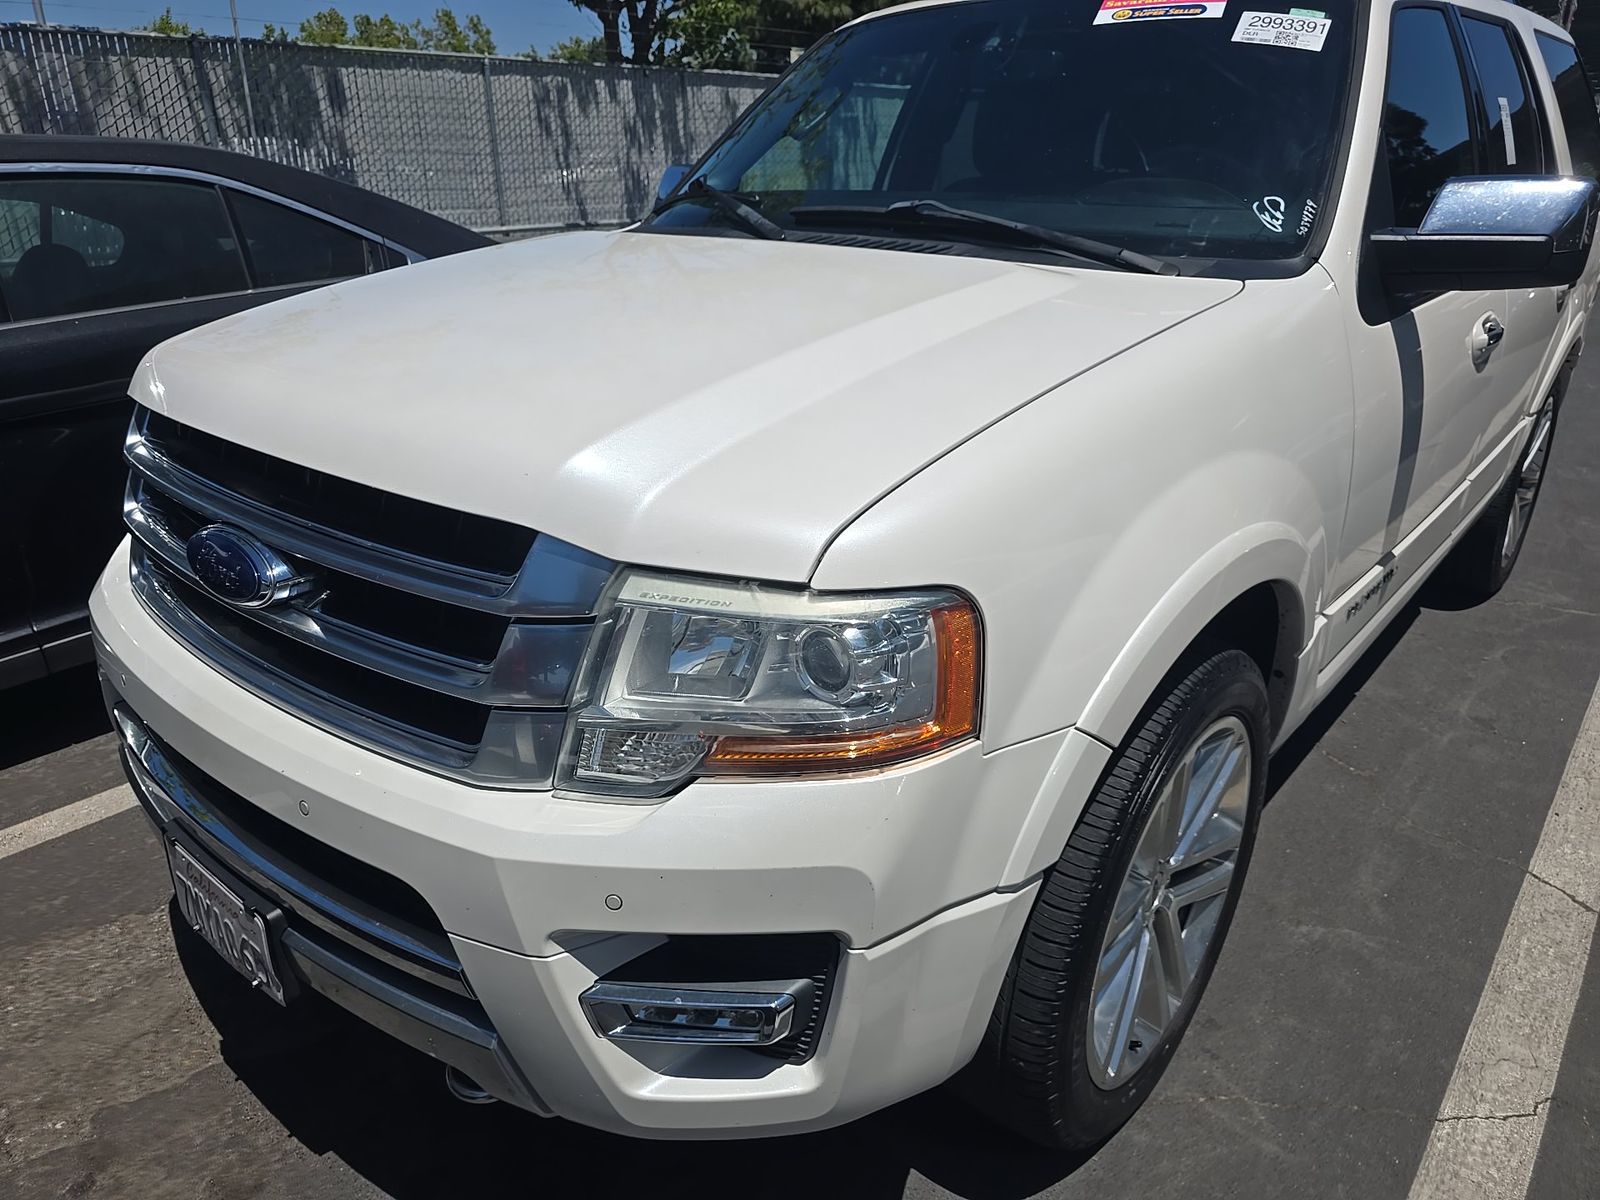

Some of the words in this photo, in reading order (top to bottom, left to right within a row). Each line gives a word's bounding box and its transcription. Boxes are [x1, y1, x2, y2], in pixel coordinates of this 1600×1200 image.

[1132, 9, 1166, 18] SUPER
[1166, 7, 1202, 15] SELLER
[1248, 15, 1327, 34] 2993391
[639, 591, 733, 607] EXPEDITION
